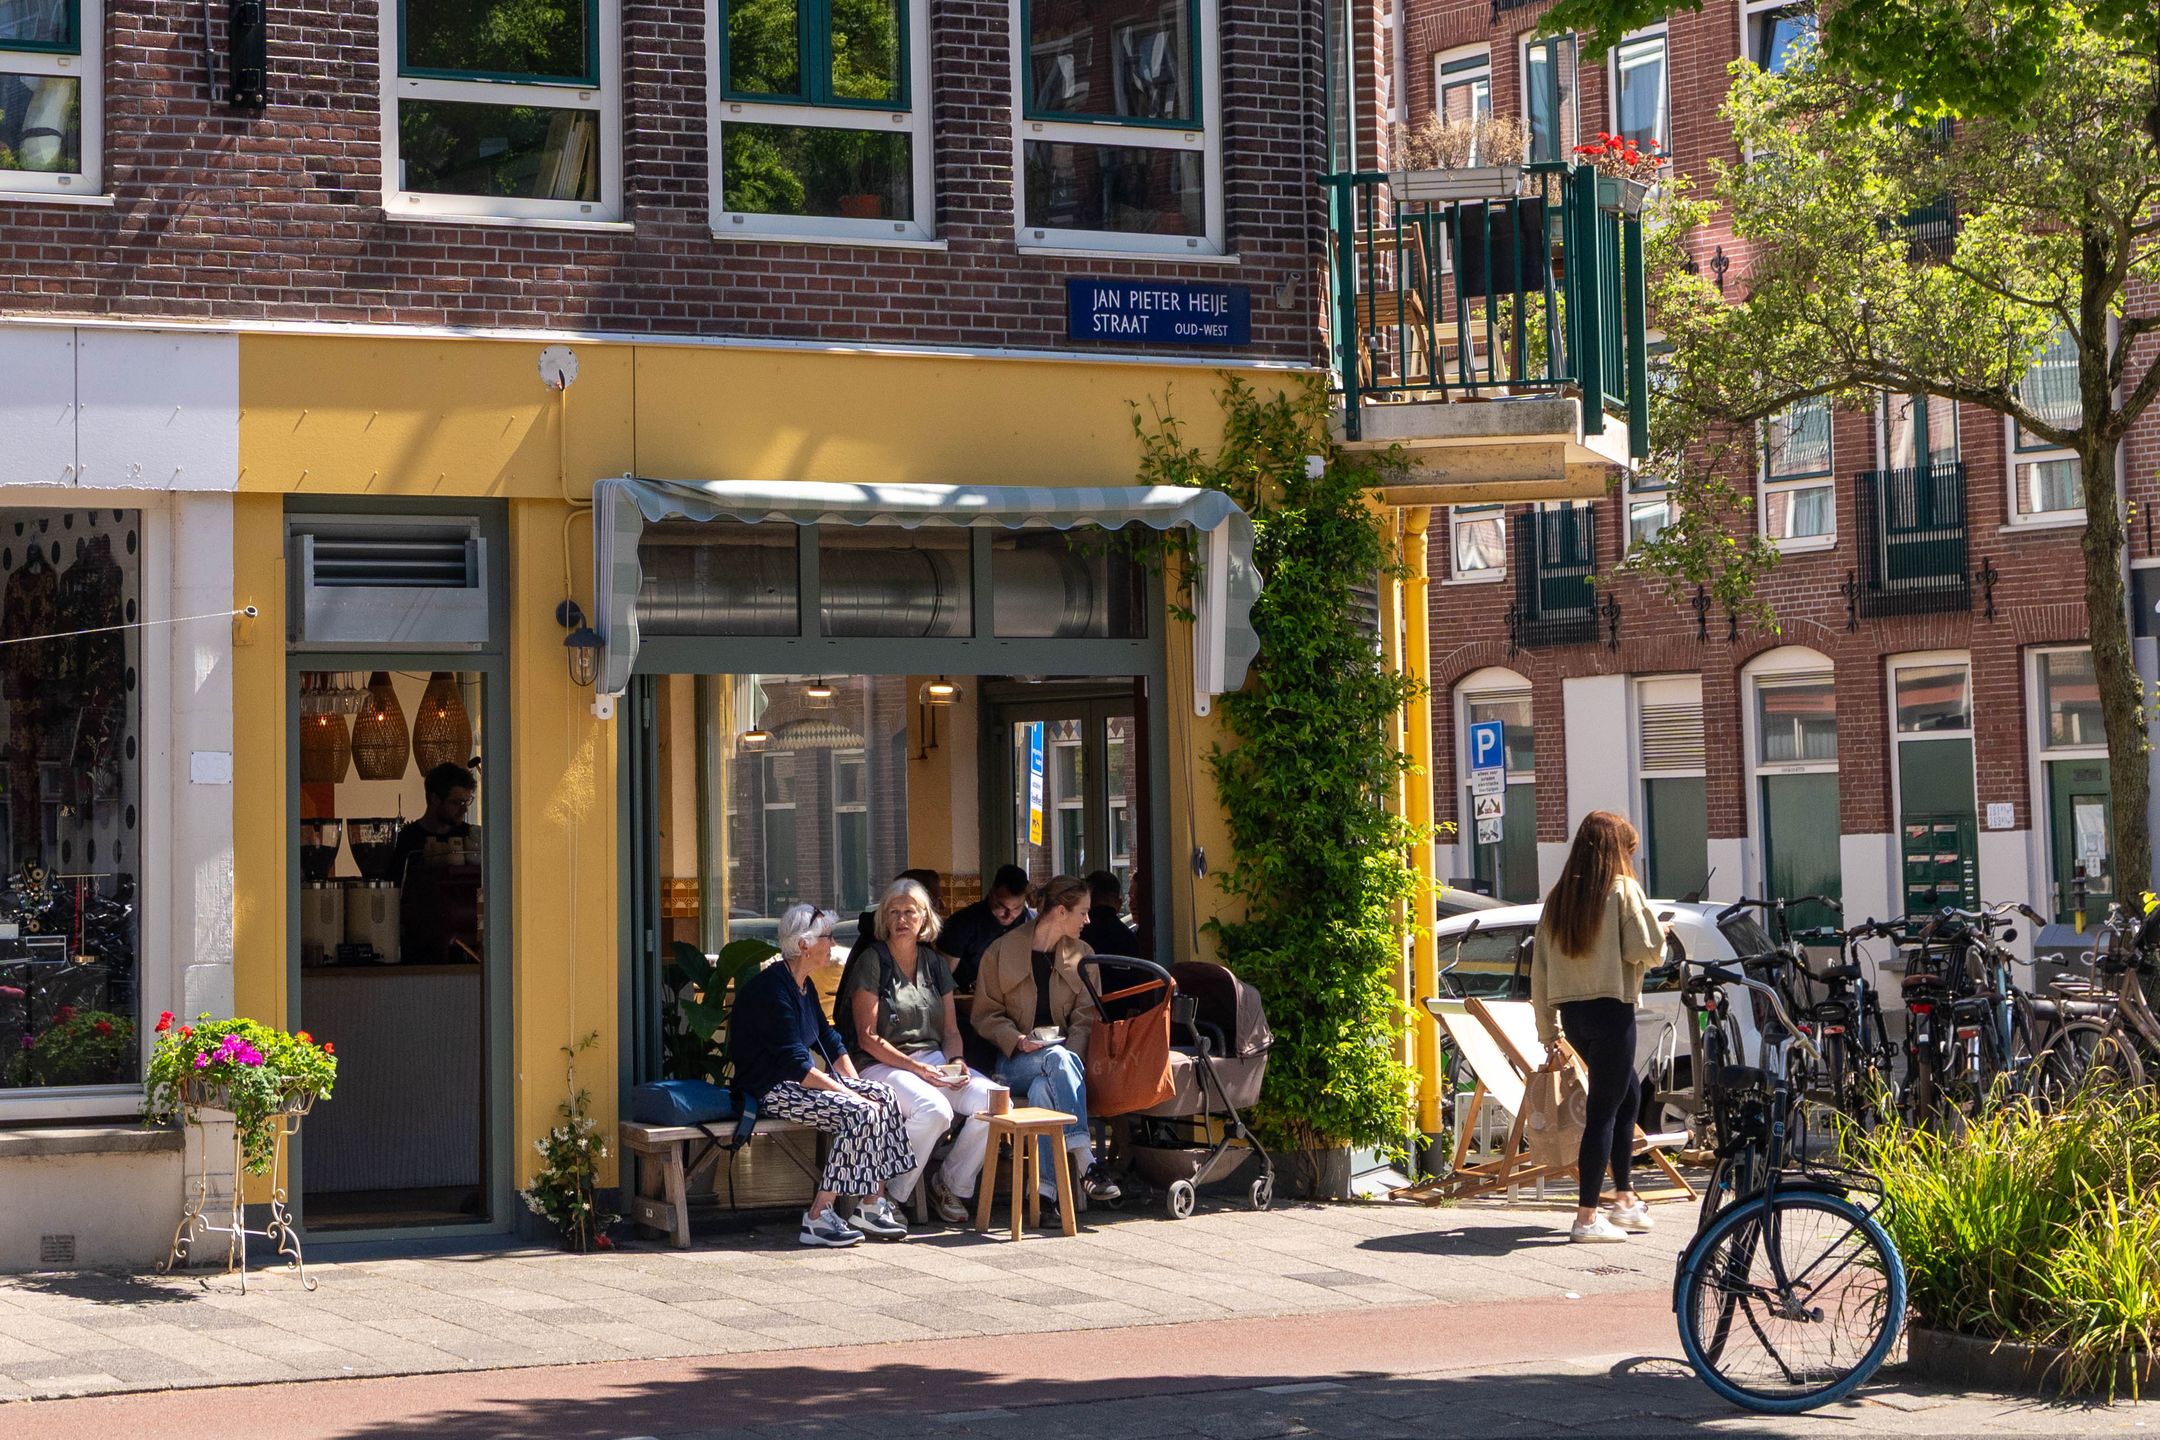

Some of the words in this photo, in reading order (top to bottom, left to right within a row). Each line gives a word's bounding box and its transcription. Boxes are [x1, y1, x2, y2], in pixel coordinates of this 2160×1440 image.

[1092, 289, 1121, 311] JAN
[1130, 291, 1181, 311] PIETER
[1189, 293, 1229, 317] HEIJE
[1093, 313, 1150, 334] STRAAT
[1175, 322, 1229, 337] OUD-WEST
[1477, 728, 1495, 764] P
